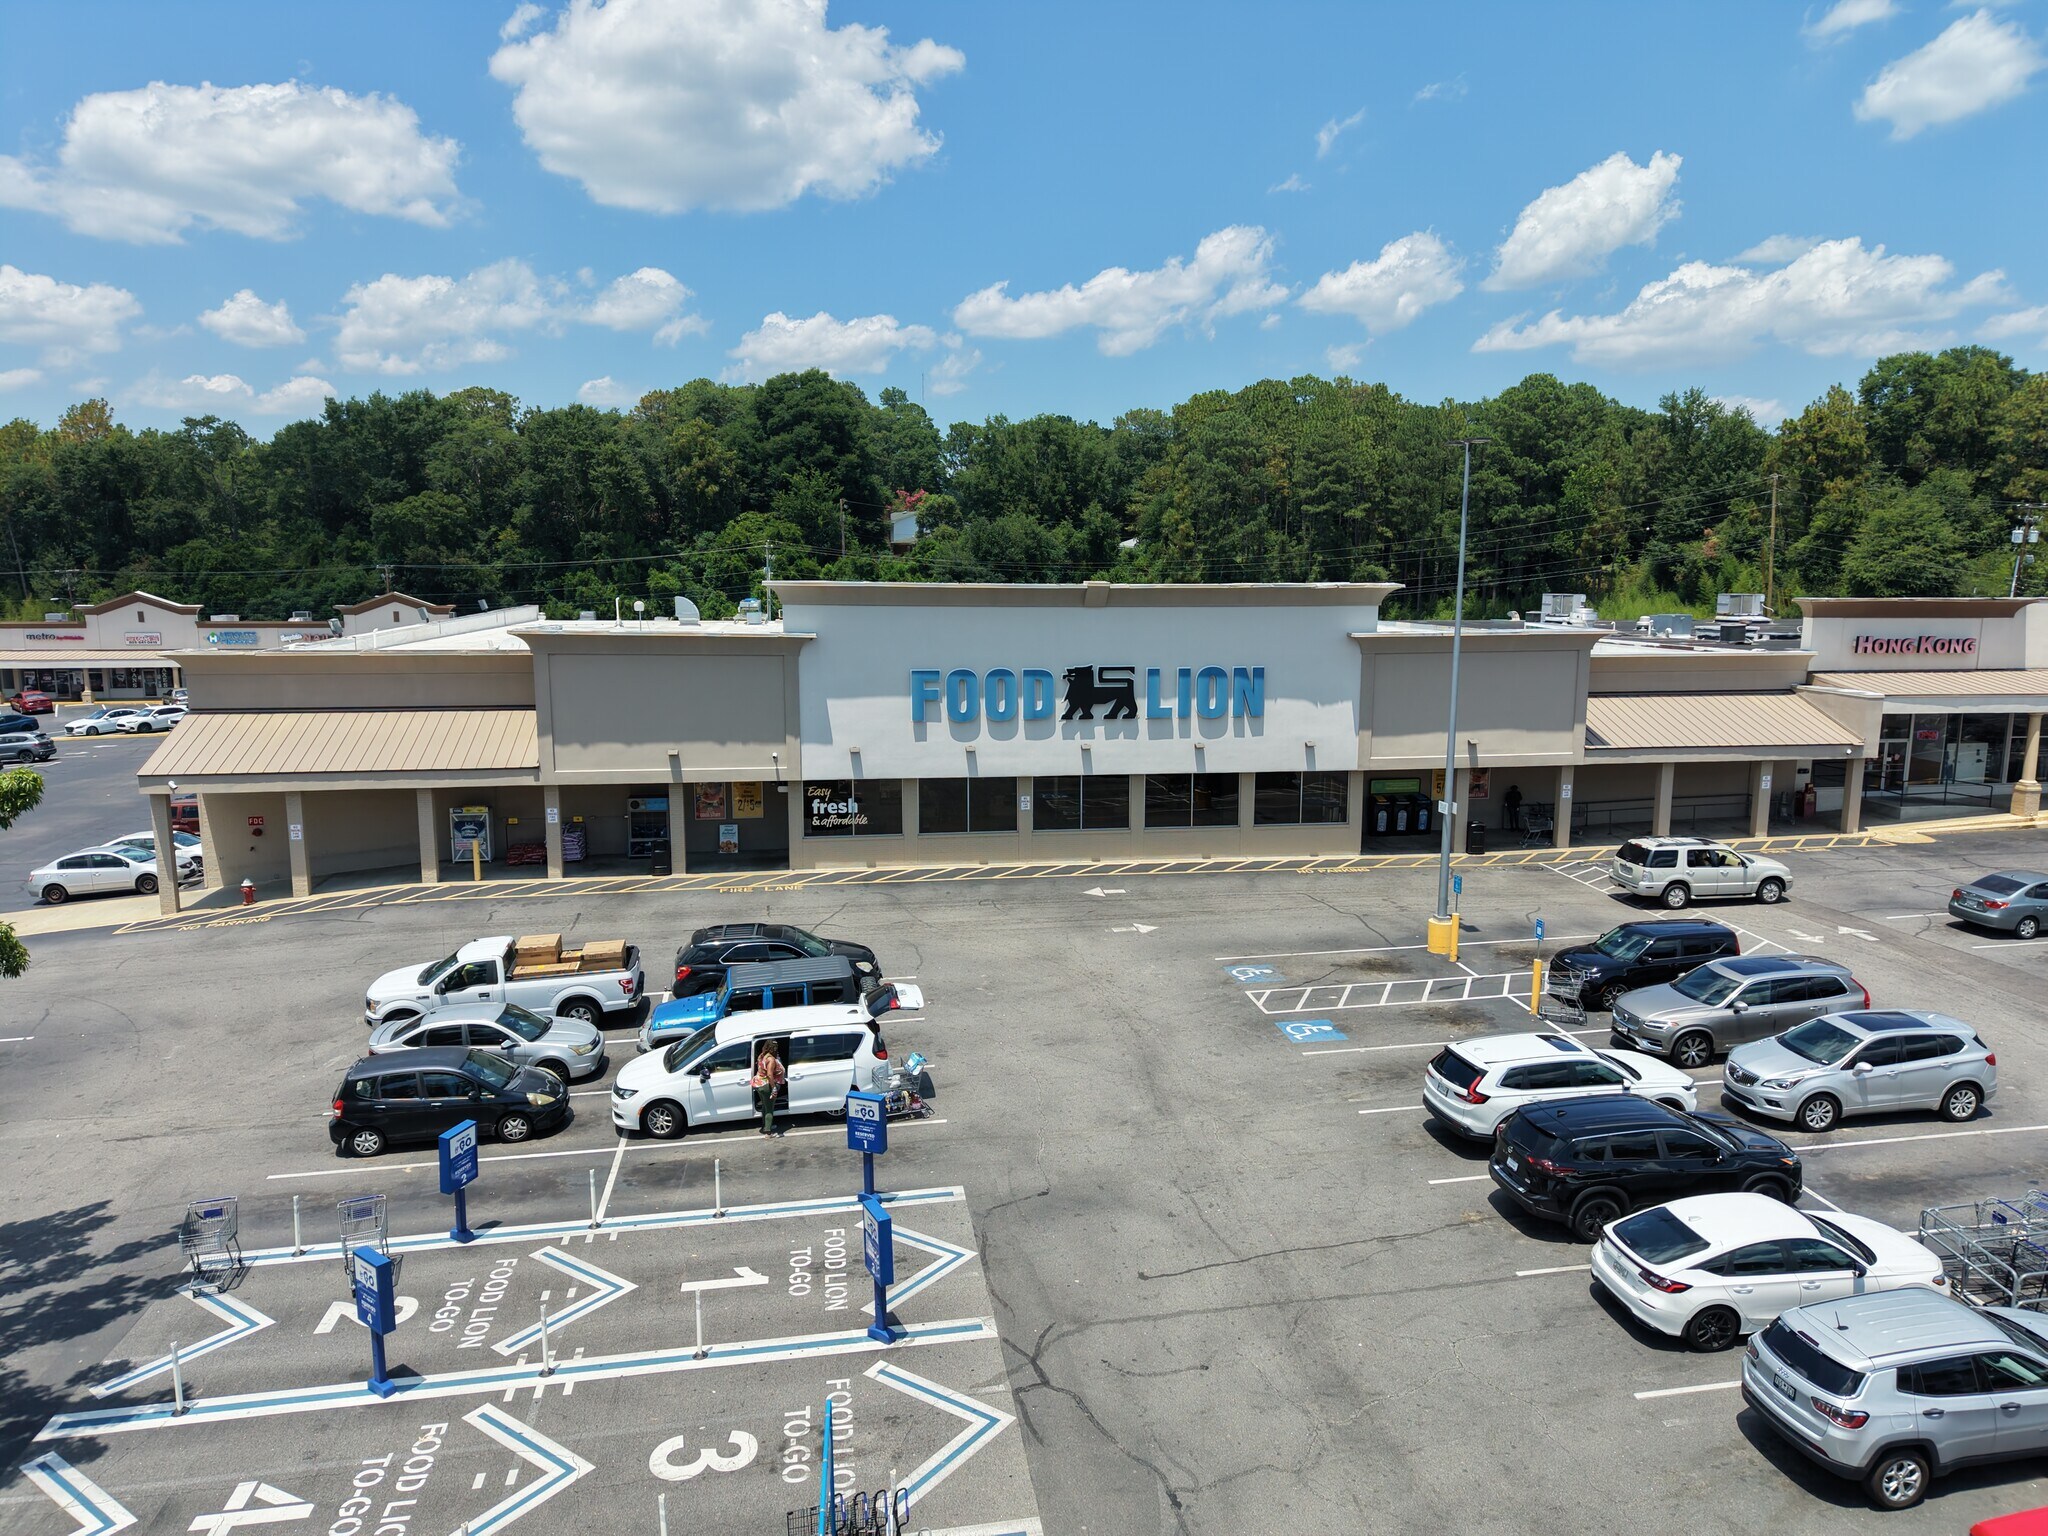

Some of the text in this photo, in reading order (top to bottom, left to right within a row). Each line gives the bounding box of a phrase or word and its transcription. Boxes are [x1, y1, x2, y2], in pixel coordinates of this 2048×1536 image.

[26, 632, 56, 641] metro
[161, 667, 169, 689] AXES
[910, 665, 1265, 723] FOOD LION
[807, 786, 831, 802] Easy
[812, 797, 859, 814] fresh
[764, 884, 804, 892] LANE
[205, 916, 273, 929] PARKING
[460, 1173, 467, 1184] 2
[680, 1266, 770, 1292] 1
[788, 1246, 812, 1297] TO-GO
[823, 1228, 848, 1312] FOOD LION
[366, 1312, 373, 1325] 4
[428, 1277, 476, 1333] TO-GO
[456, 1258, 519, 1349] FOOD LION
[825, 1378, 854, 1442] FOOD
[648, 1429, 759, 1482] 3
[781, 1405, 811, 1484] TO-GO
[328, 1452, 395, 1536] TO-GO
[374, 1422, 449, 1536] FOOD LIO
[187, 1480, 315, 1536] 4
